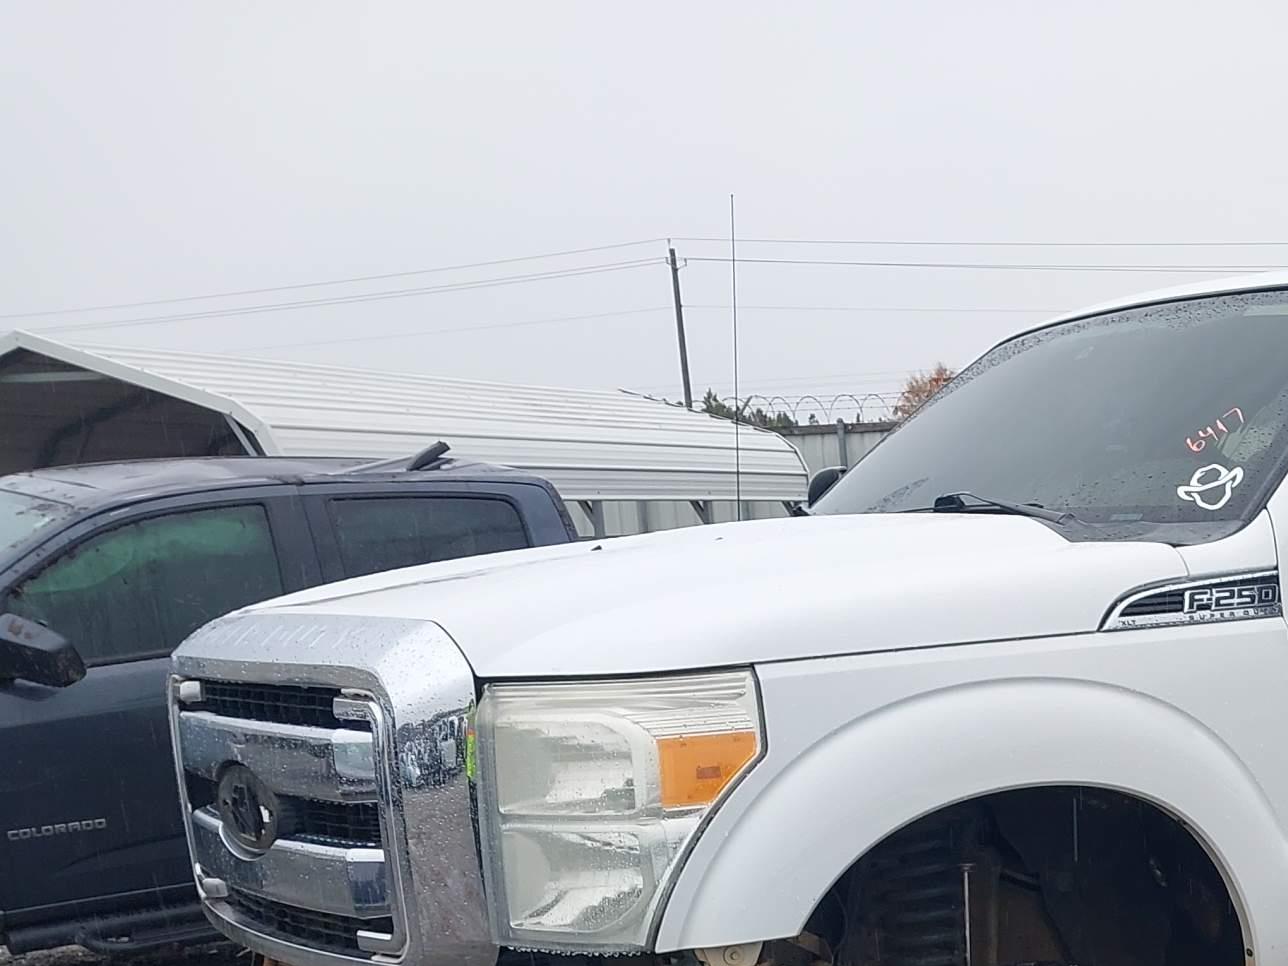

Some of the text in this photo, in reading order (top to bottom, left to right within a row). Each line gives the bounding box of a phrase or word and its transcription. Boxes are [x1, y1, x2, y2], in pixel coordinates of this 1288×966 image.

[1186, 407, 1245, 452] 6417
[1183, 583, 1279, 613] F-250
[1188, 612, 1236, 621] SUPER
[7, 818, 107, 840] COLORADO
